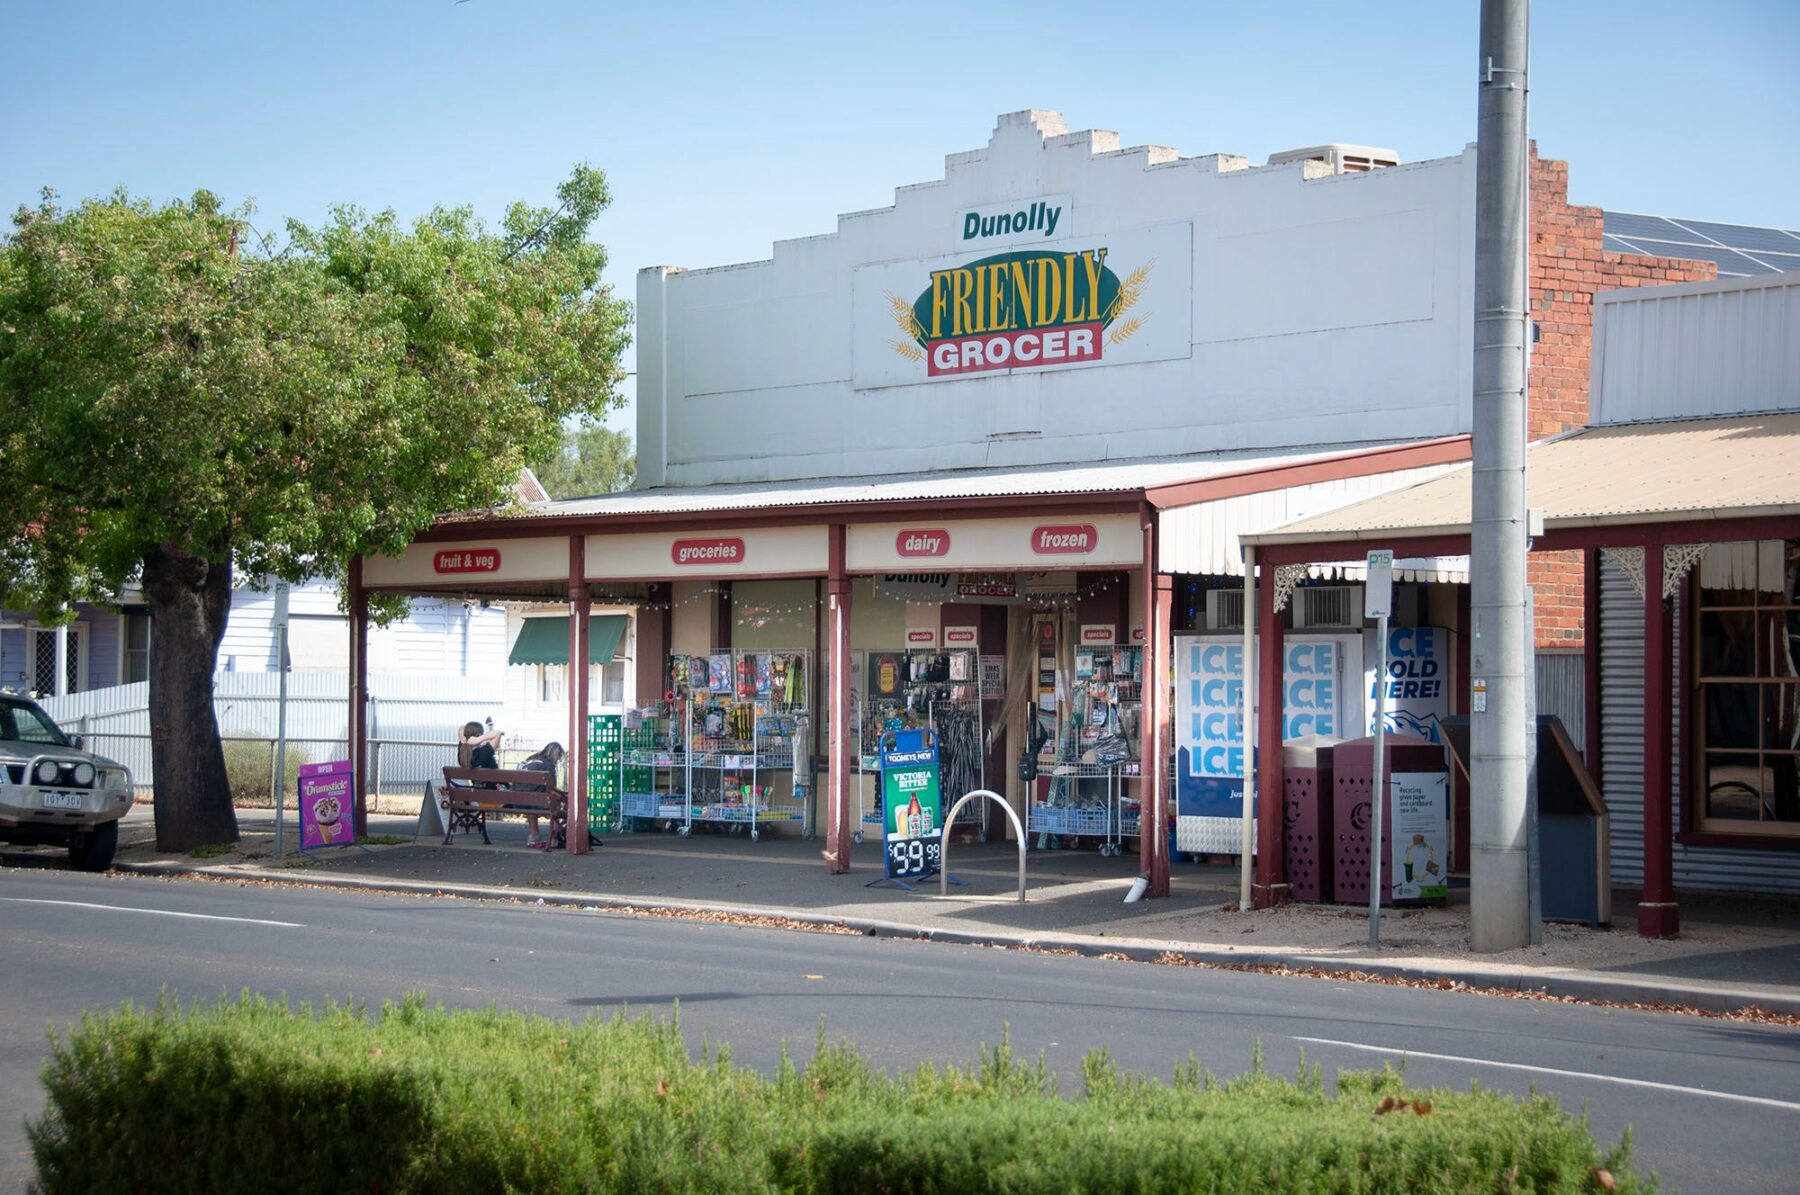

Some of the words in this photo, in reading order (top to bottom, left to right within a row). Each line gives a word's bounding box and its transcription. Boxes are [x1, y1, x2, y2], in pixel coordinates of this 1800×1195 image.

[963, 201, 1062, 240] Dunolly
[930, 248, 1107, 338] FRIENDLY
[933, 328, 1094, 370] GROCER
[905, 535, 941, 553] dairy
[1040, 531, 1088, 548] frozen
[680, 543, 737, 561] groceries
[440, 554, 462, 568] fruit
[464, 554, 472, 567] &
[476, 555, 494, 569] veg
[959, 584, 1014, 596] GROCER
[910, 632, 932, 641] specials
[950, 632, 971, 641] specials
[1389, 627, 1434, 658] CE
[1191, 645, 1243, 674] ICE
[1375, 660, 1438, 678] OLD
[1192, 679, 1243, 708] ICE
[1192, 713, 1243, 742] ICE
[1192, 746, 1244, 776] ICE
[893, 771, 932, 782] VICTORIA
[899, 779, 928, 788] BITTER
